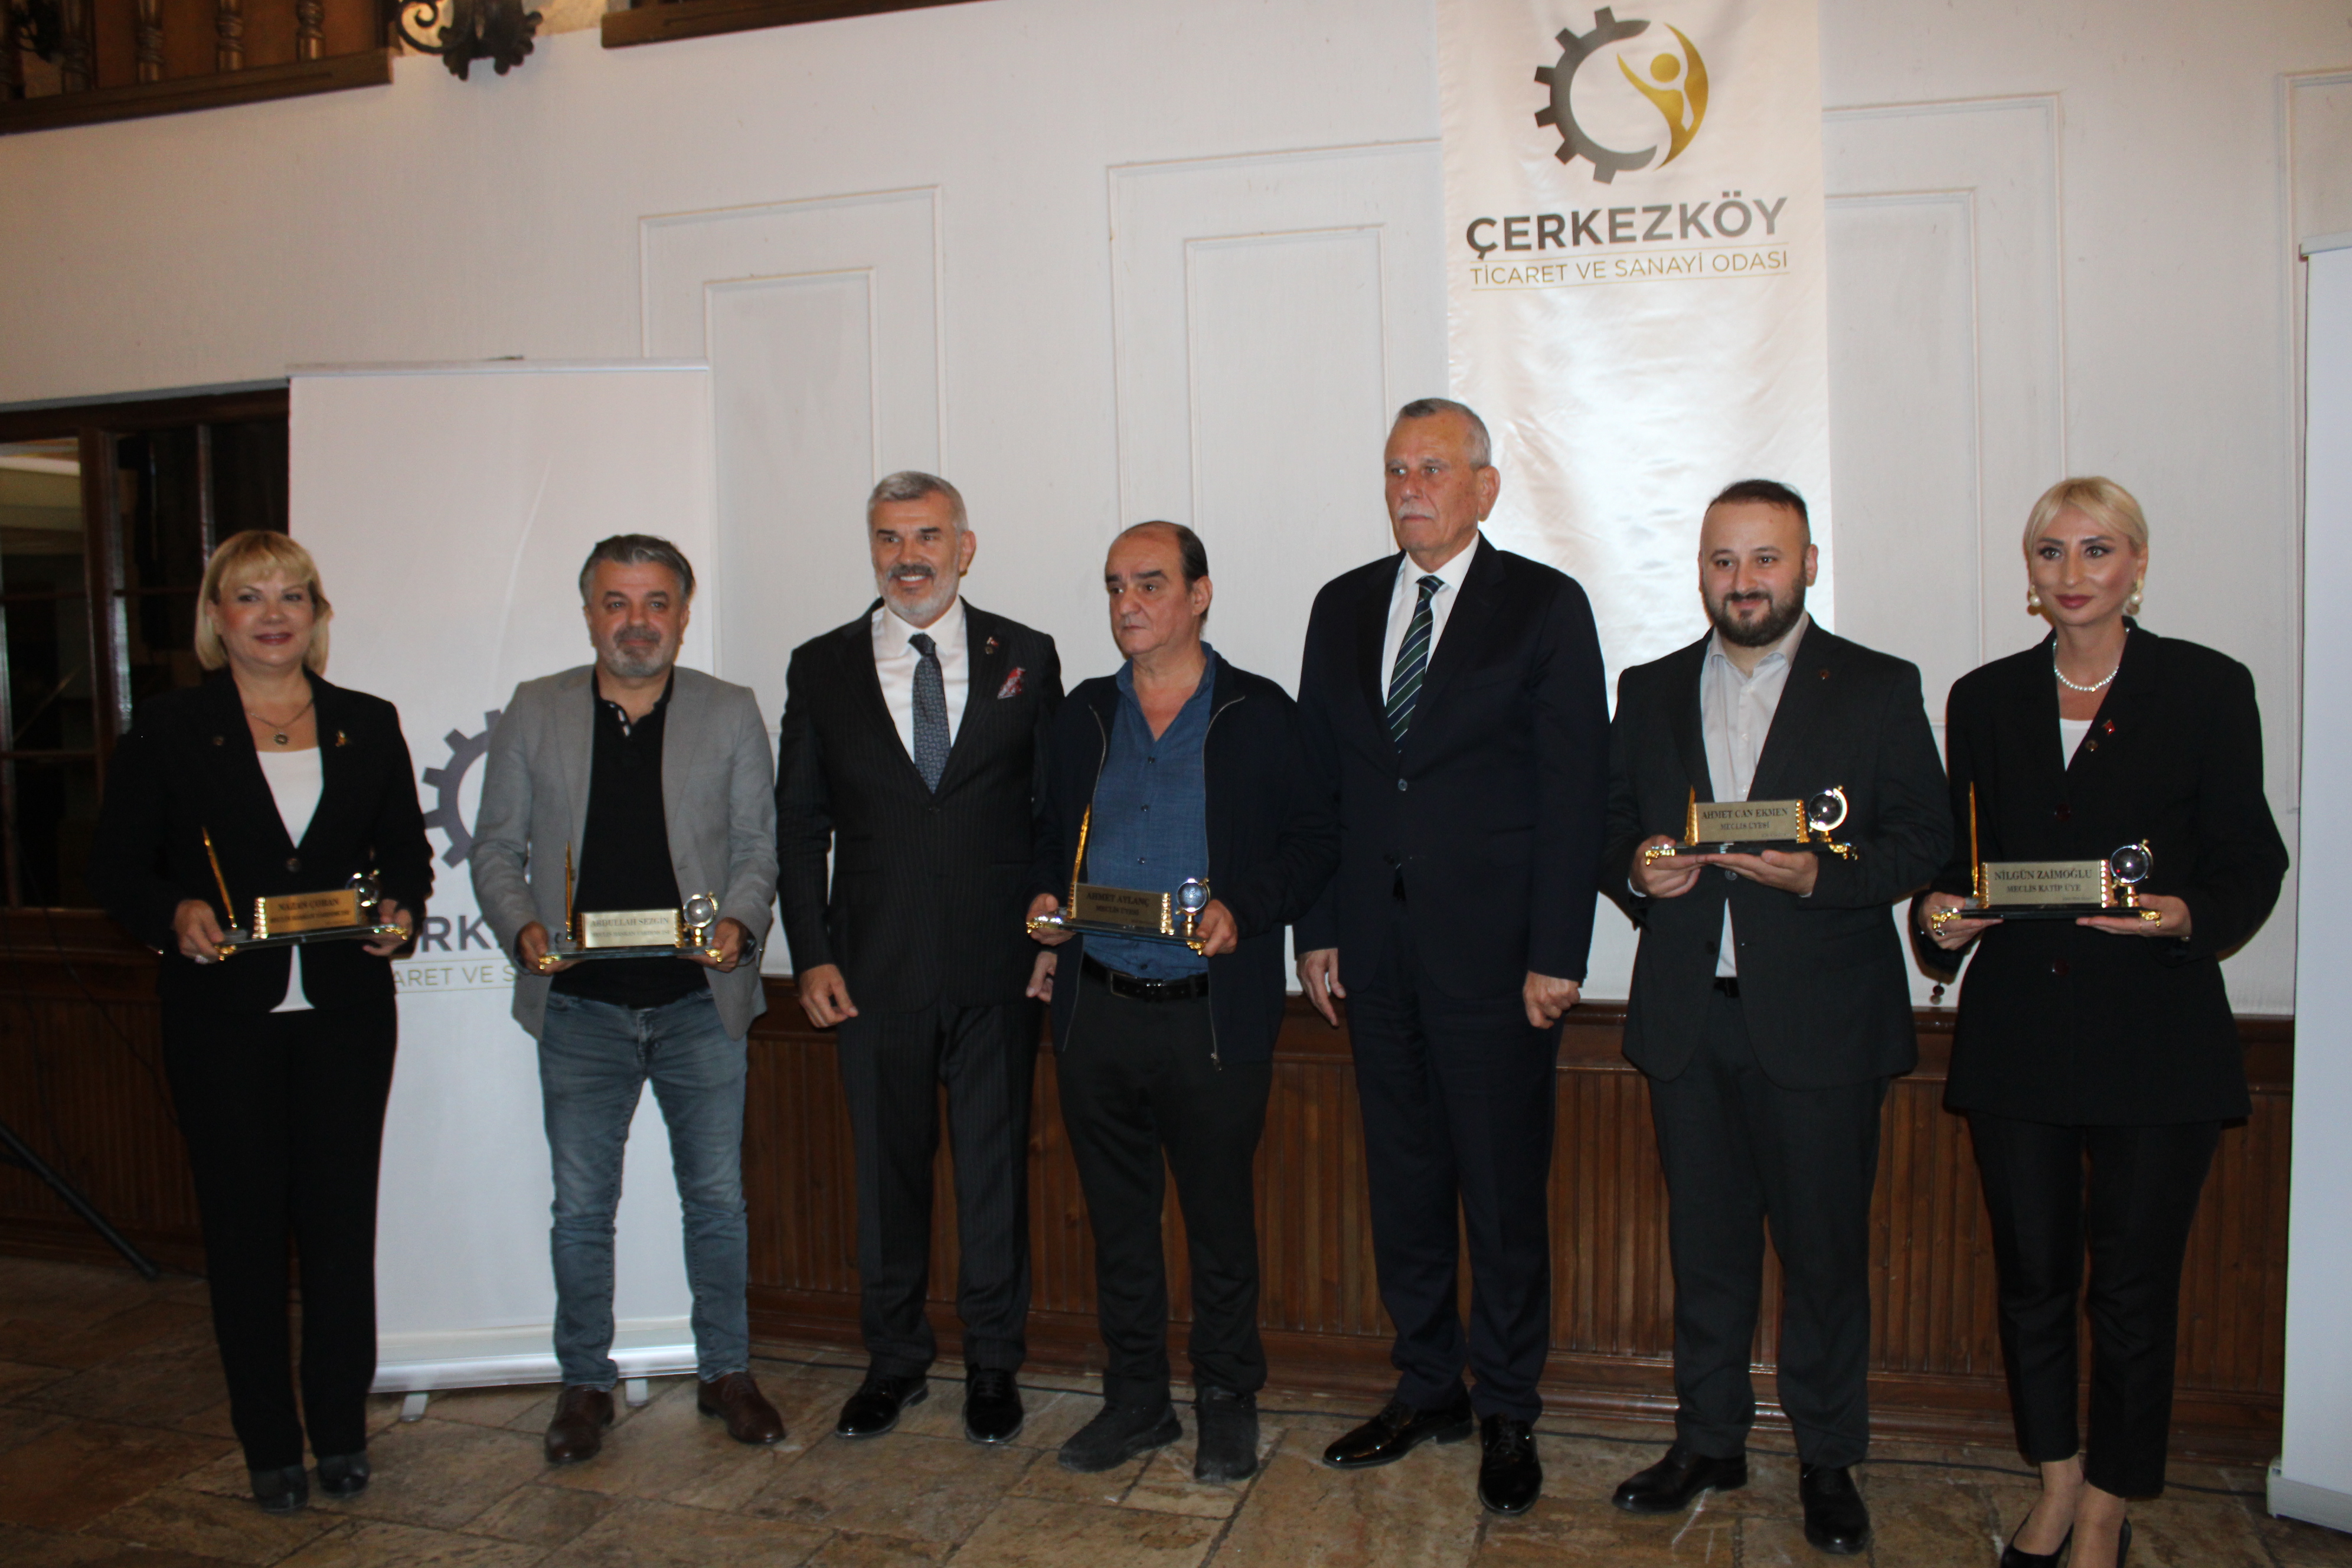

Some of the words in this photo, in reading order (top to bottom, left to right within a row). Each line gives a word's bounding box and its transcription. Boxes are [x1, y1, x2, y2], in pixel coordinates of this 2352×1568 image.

[1466, 190, 1788, 260] ÇERKEZKÖY
[1470, 263, 1567, 285] TİCARET
[1576, 261, 1606, 279] VE
[1615, 252, 1703, 277] SANAYİ
[1712, 250, 1788, 272] ODASI
[1701, 809, 1733, 819] AHMET
[1734, 809, 1753, 818] CAN
[1755, 808, 1788, 818] EKMEN
[1994, 868, 2034, 881] NİLGÜN
[2037, 868, 2092, 880] ZAİMOĞLU
[1086, 892, 1116, 903] AHMET
[591, 919, 636, 927] ABDULLAH
[638, 917, 669, 926] SEZGİN
[394, 968, 453, 986] ARET
[462, 965, 494, 984] VE
